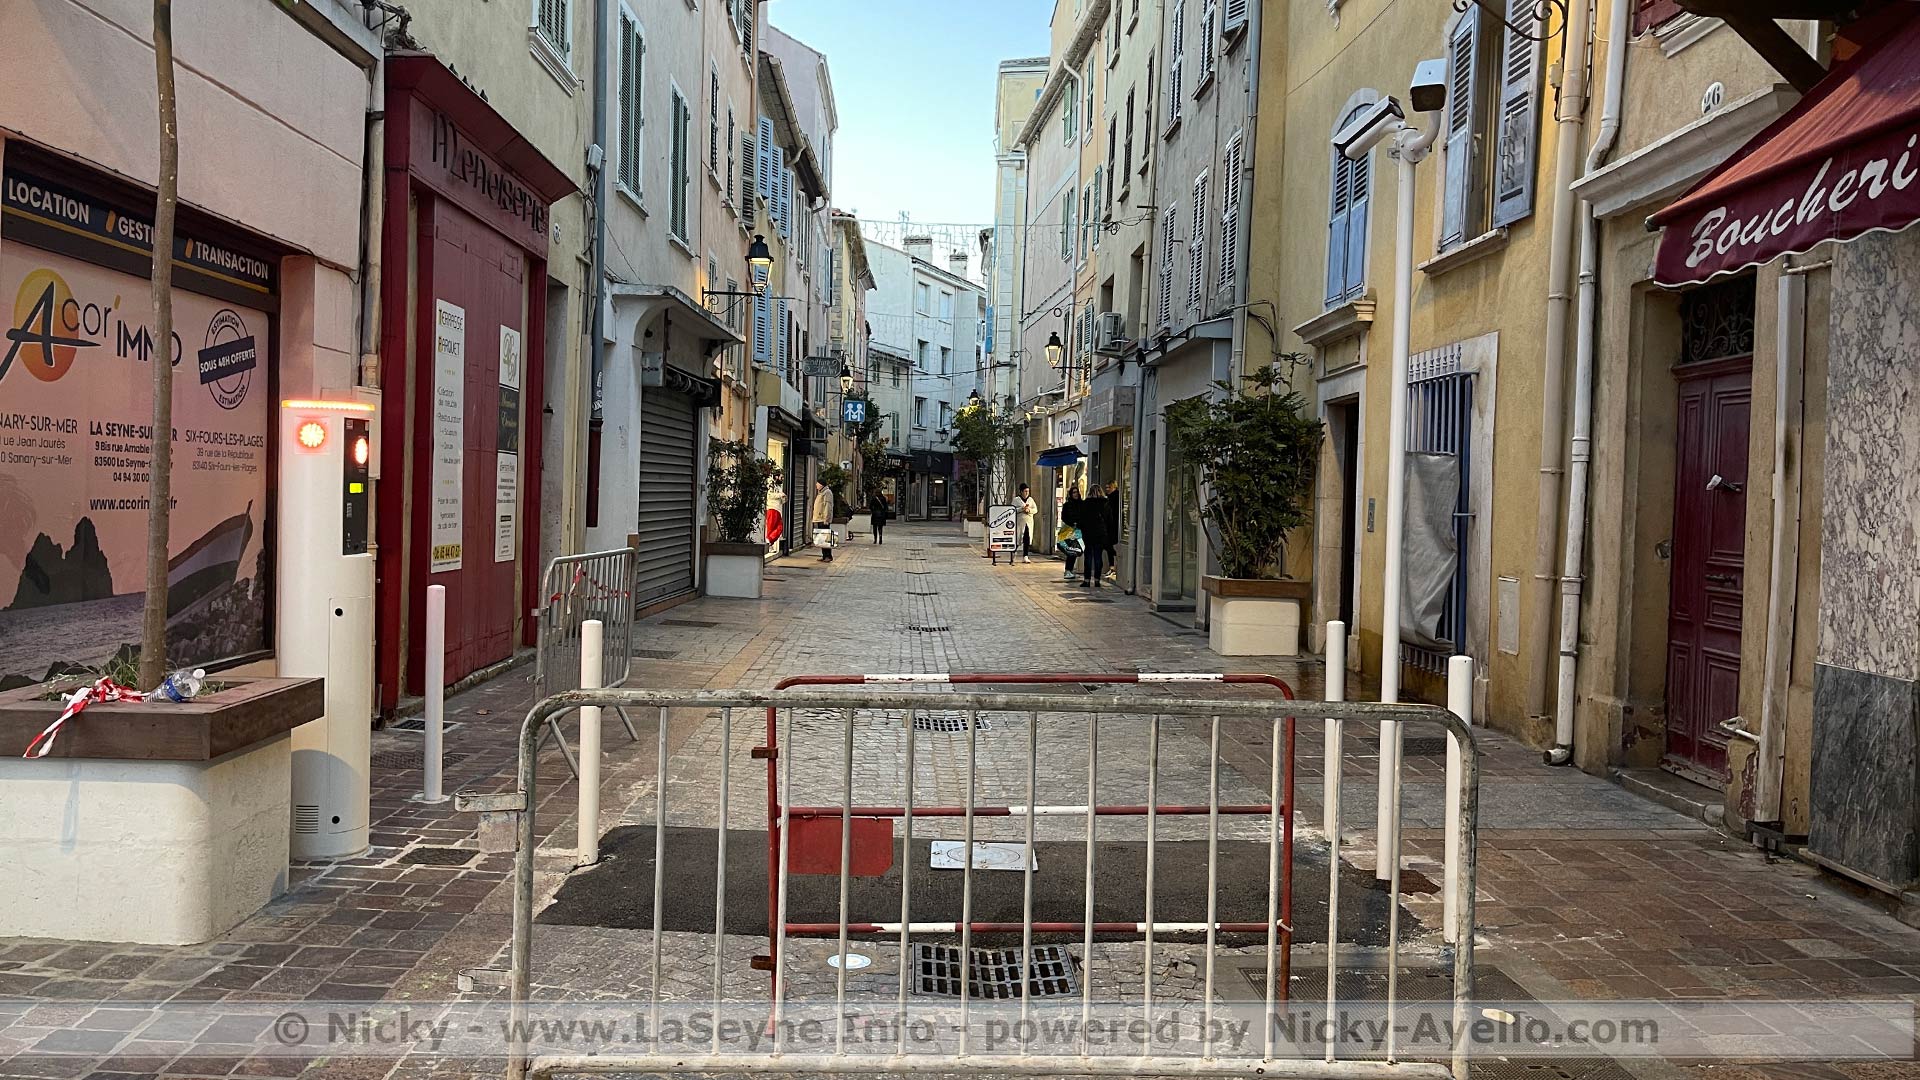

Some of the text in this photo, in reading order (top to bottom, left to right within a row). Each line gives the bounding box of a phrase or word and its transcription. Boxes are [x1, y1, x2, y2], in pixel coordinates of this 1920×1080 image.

[1703, 86, 1721, 113] 26
[1685, 133, 1918, 268] Boucheri
[8, 178, 269, 280] LOCATION GESTI TRANSACTION
[211, 315, 239, 335] ESTIMATION
[200, 348, 255, 373] SOUS 48H OFFERTE
[218, 384, 245, 406] ESTIMATION
[90, 421, 178, 442] LA SEYNE-SUR
[185, 429, 264, 448] SIX-FOURS-LES-PLAGES
[16, 437, 37, 448] Jean
[39, 438, 66, 449] Jaurès
[95, 441, 100, 451] 9
[101, 441, 111, 452] Bis
[112, 443, 123, 453] rue
[9, 452, 72, 467] Sanary-sur-Mer
[94, 456, 116, 467] 83500
[117, 458, 125, 468] La
[113, 472, 121, 482] 04
[132, 472, 141, 482] 30
[141, 473, 150, 483] 00
